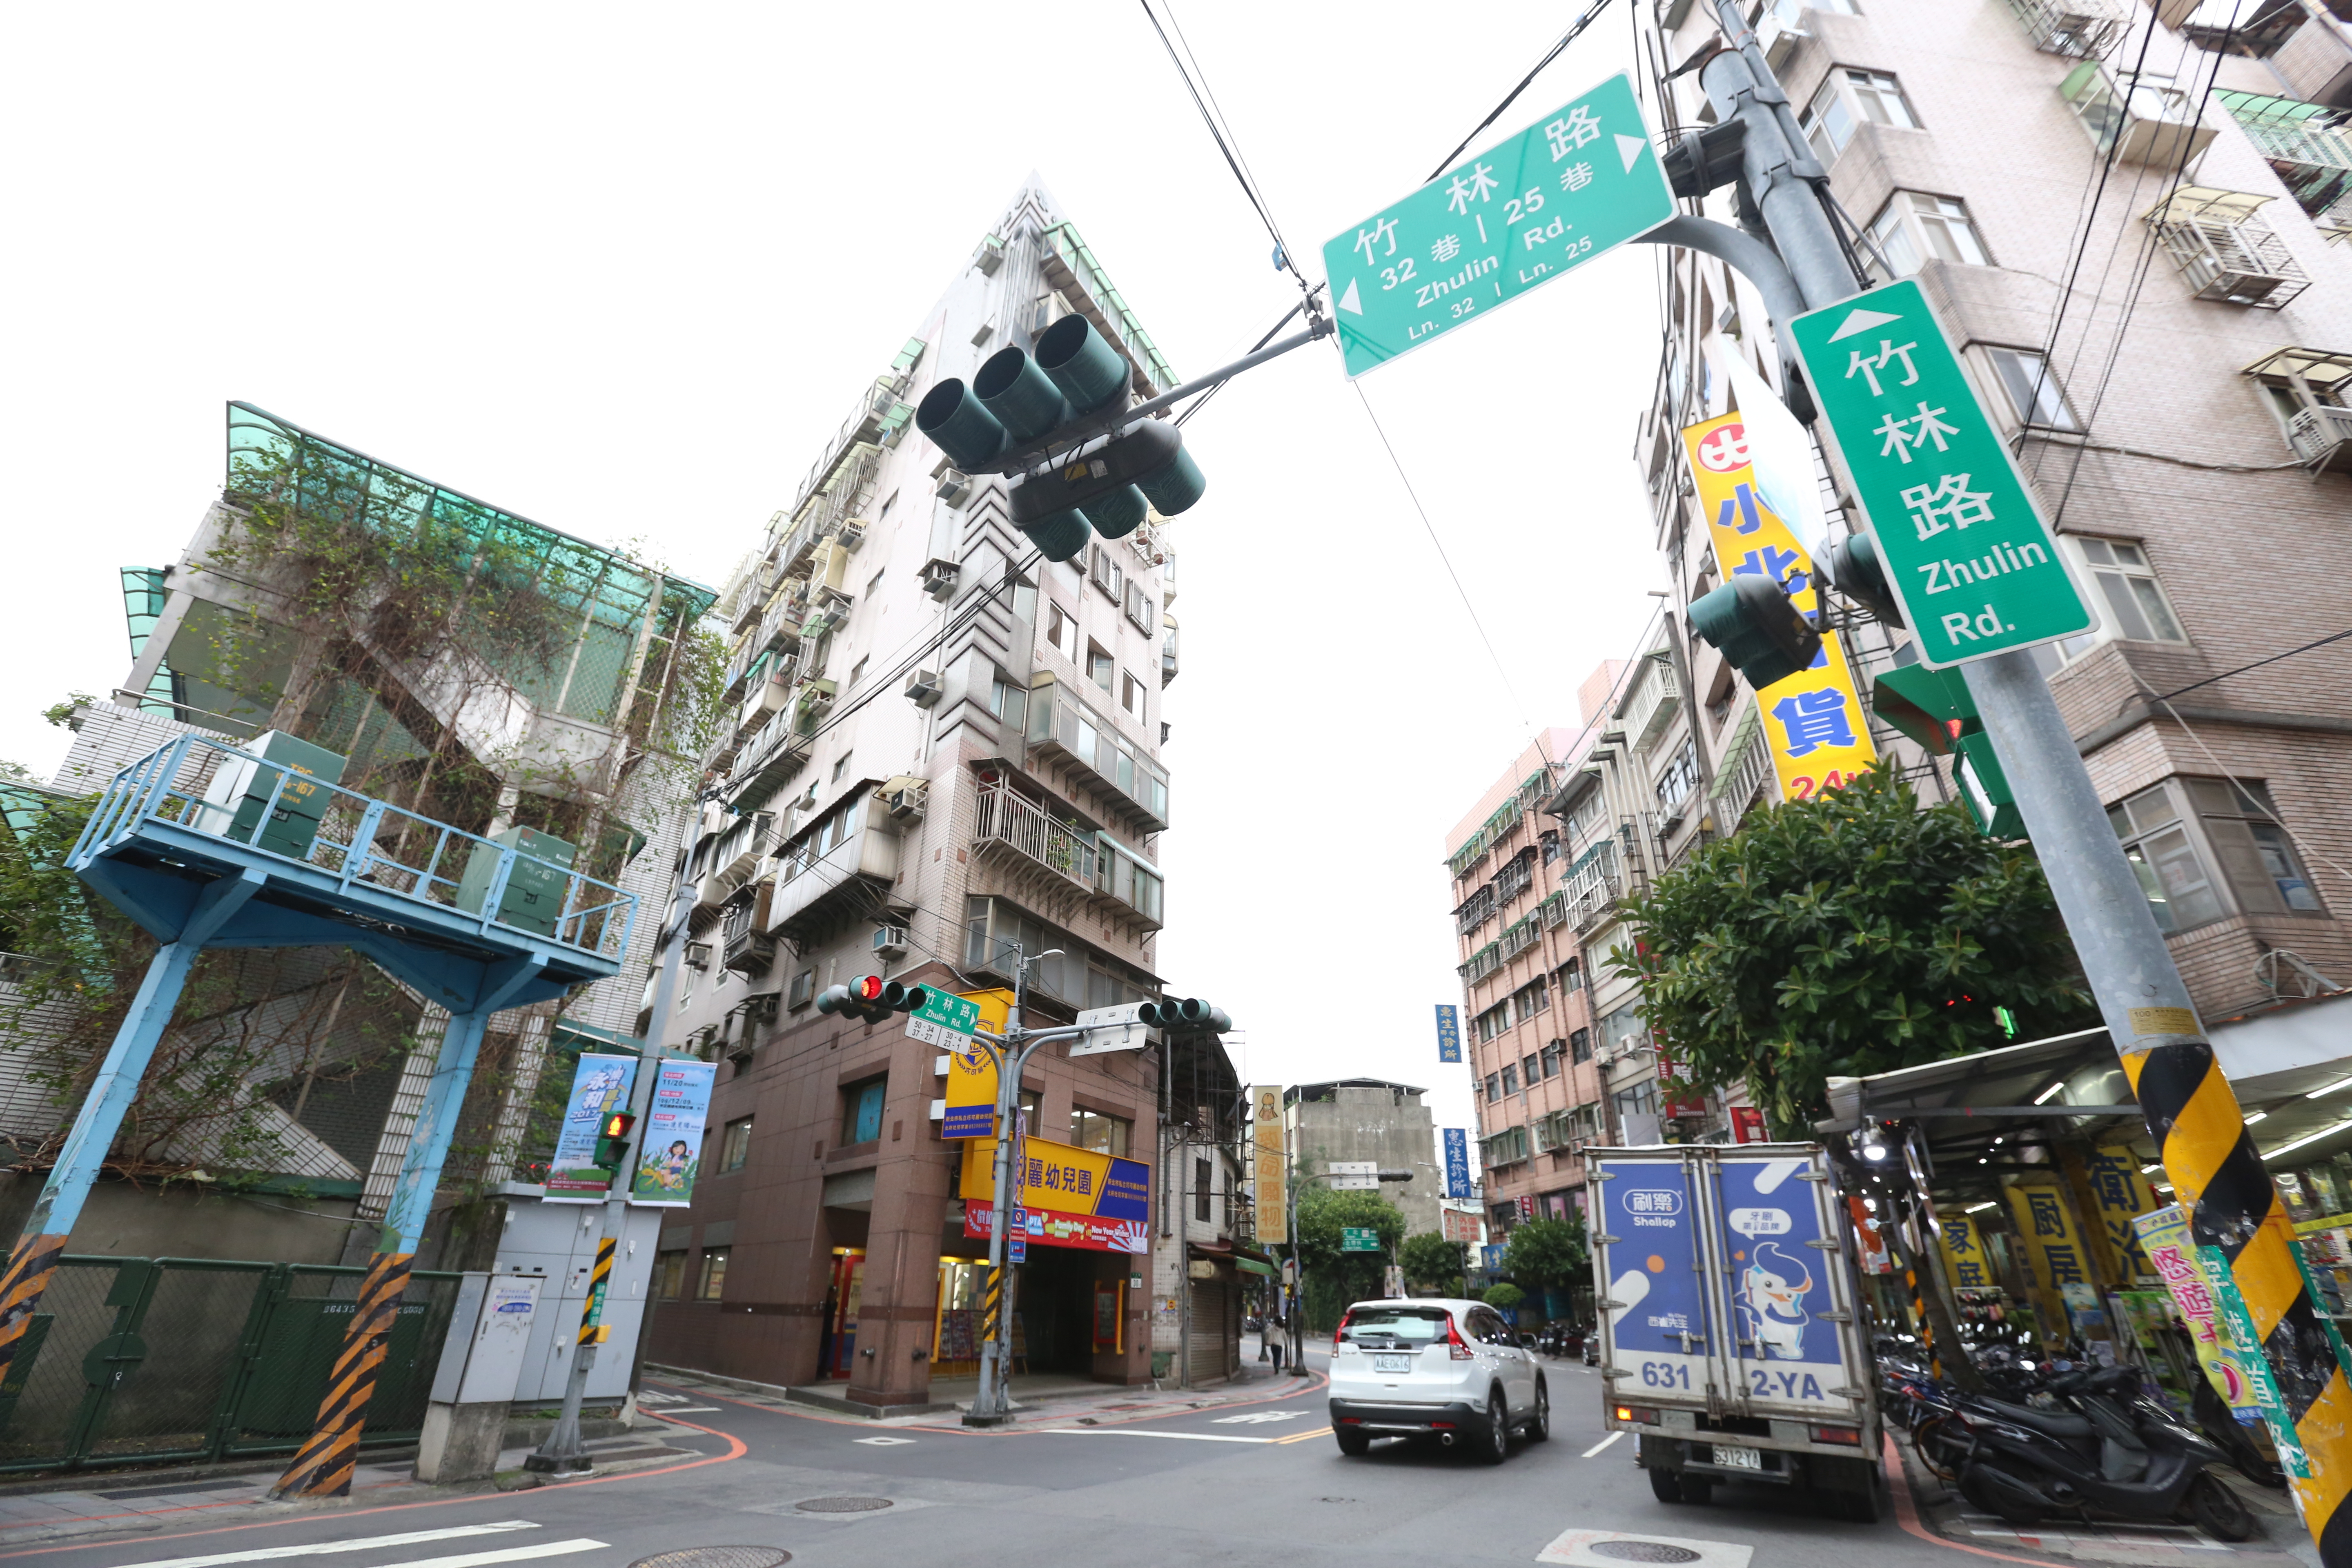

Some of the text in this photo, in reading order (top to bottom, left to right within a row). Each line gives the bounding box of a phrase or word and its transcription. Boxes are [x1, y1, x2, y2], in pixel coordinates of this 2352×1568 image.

[1415, 216, 1572, 309] Zhulin Rd.
[1408, 236, 1592, 340] Ln. 32 Ln. 25
[1845, 339, 1993, 542] 竹林路
[1917, 542, 2049, 596] Zhulin
[1942, 610, 2015, 646] Rd.
[926, 990, 971, 1018] 竹林路
[926, 1009, 961, 1028] Zhulin Rd.
[1448, 1129, 1467, 1195] 惠生診所
[1054, 1219, 1073, 1231] Family
[1103, 1227, 1114, 1235] Year
[1642, 1362, 1824, 1401] 631 2-YA
